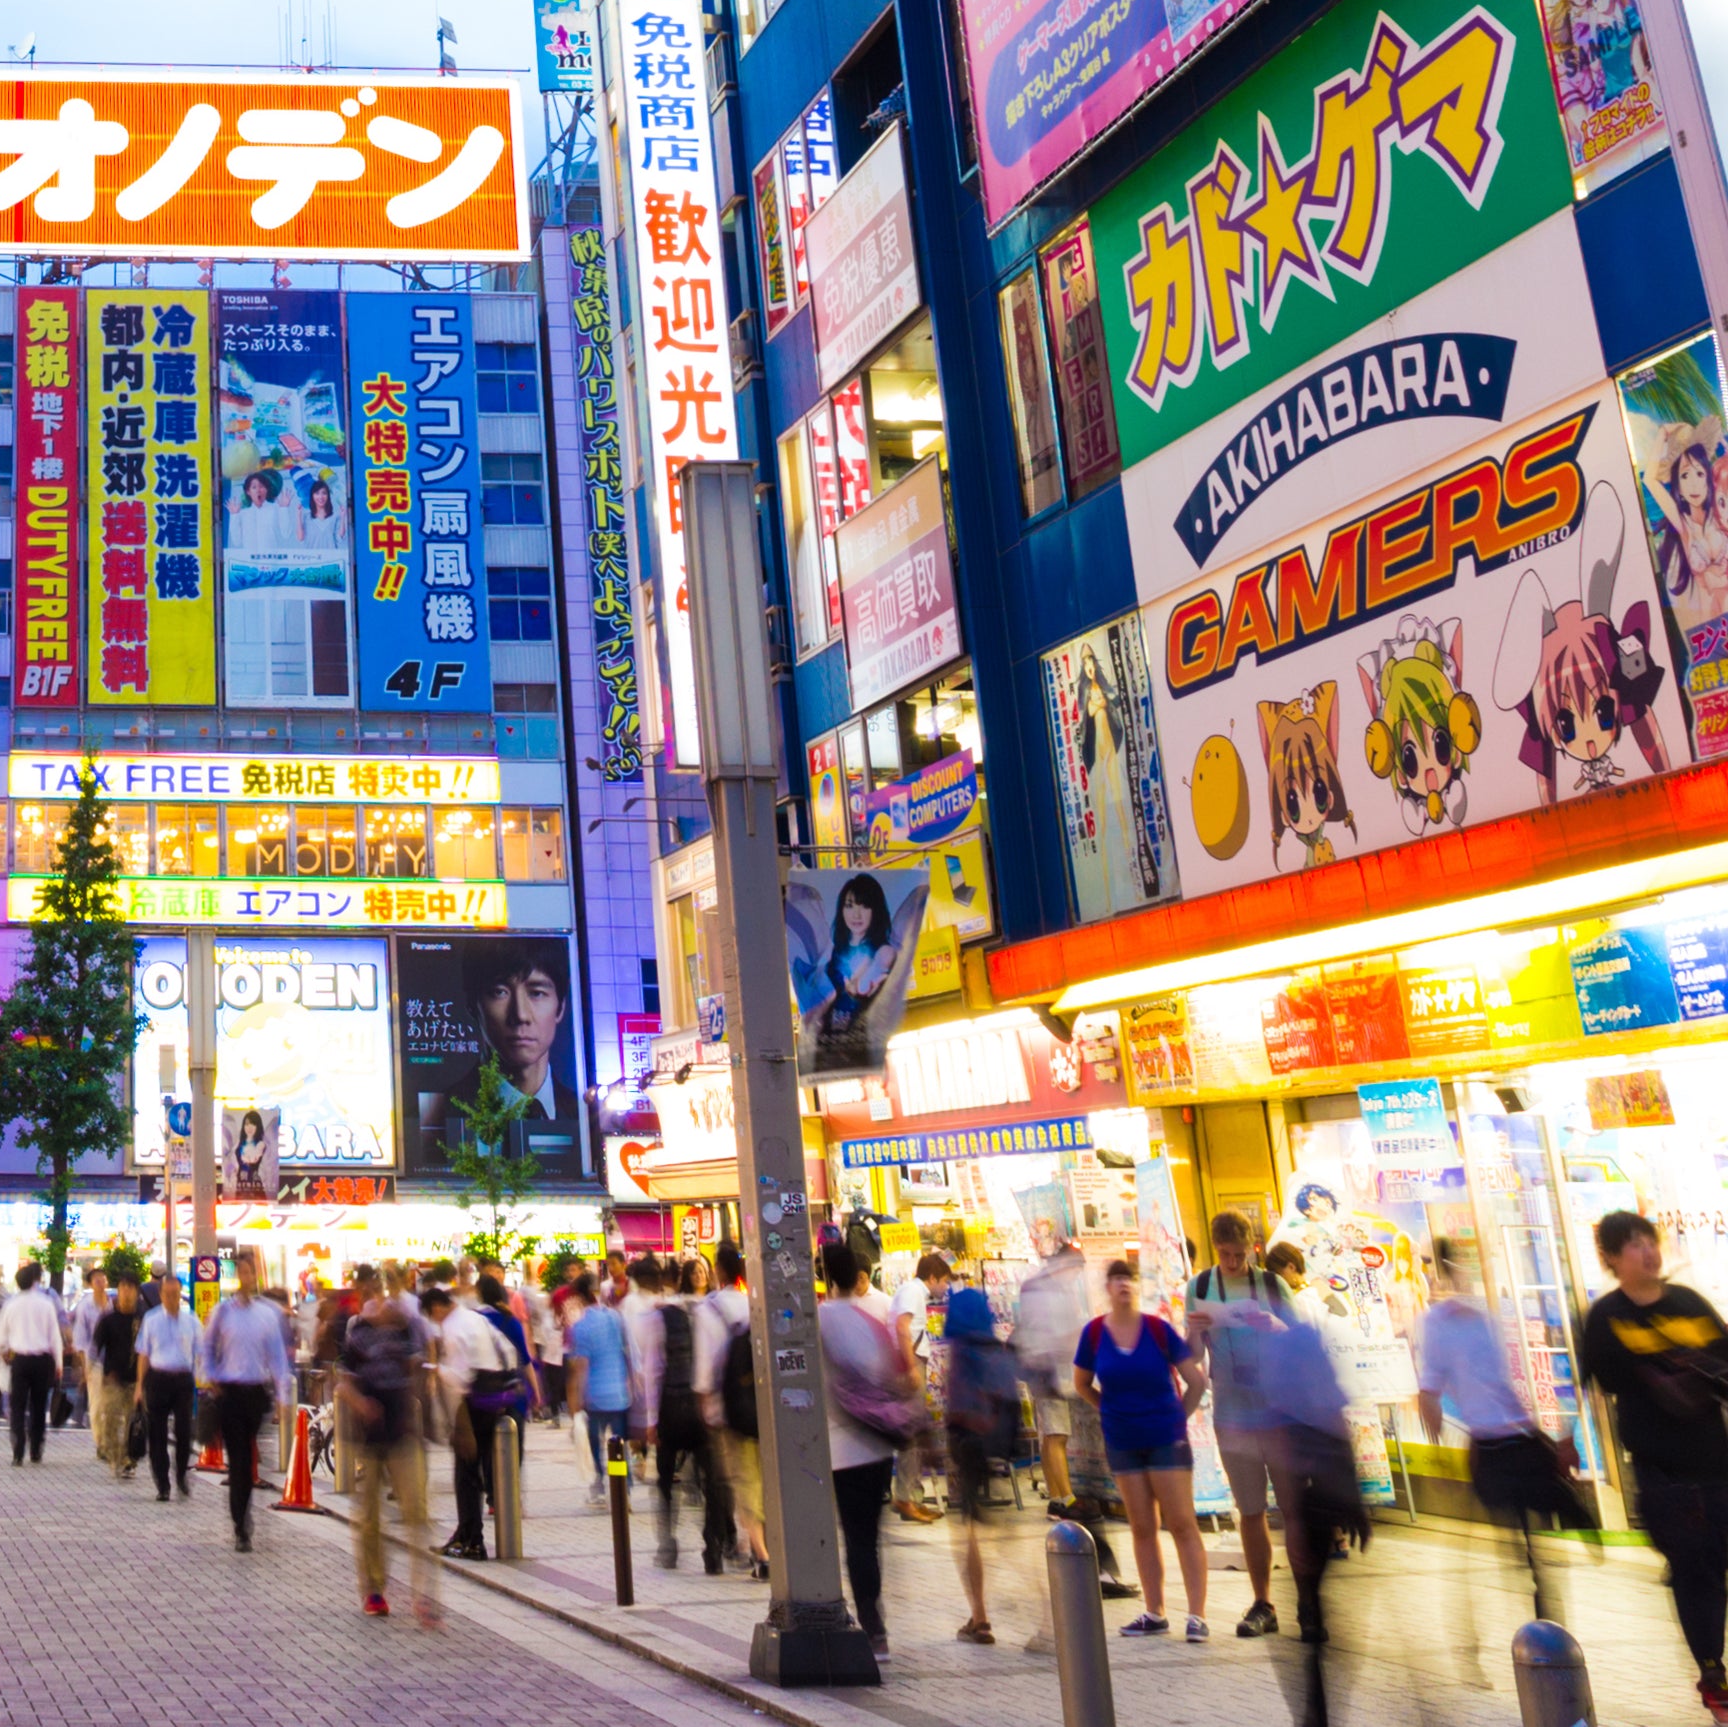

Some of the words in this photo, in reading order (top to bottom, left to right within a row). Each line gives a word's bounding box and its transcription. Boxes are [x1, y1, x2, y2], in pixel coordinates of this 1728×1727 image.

[630, 11, 704, 173] 免税商店
[222, 295, 269, 305] TOSHIBA
[25, 298, 72, 390] 免税
[222, 322, 339, 339] スペースそのまま、
[222, 338, 313, 353] たっぷり入る。
[843, 297, 896, 362] TAKARADA
[100, 303, 147, 498] 都内・近郊
[1207, 336, 1472, 537] AKIHABARA
[361, 372, 413, 603] 大特売中!!
[412, 305, 477, 645] エアコン扇風機
[1165, 406, 1594, 698] GAMERS
[1506, 526, 1572, 565] ANIBRO
[26, 485, 71, 664] DUTYFREE
[101, 500, 150, 694] 送料無料
[852, 552, 942, 650] 高価買取
[877, 633, 935, 685] TAKARADA
[20, 665, 73, 698] B1F
[383, 658, 467, 702] 4F
[30, 763, 113, 793] TAX
[126, 764, 231, 794] FREE
[239, 762, 336, 797] 免税店
[347, 763, 476, 798] 特売中!!
[813, 748, 834, 774] 2F
[909, 761, 964, 805] DISCOUNT
[908, 788, 974, 831] COMPUTERS
[870, 821, 891, 852] 2F
[128, 887, 221, 916] 冷蔵庫
[236, 890, 353, 917] エアコン
[363, 887, 488, 921] 特売中!!
[410, 941, 453, 952] Panasonic
[140, 960, 379, 1012] OODEN
[405, 998, 455, 1019] 教えて
[406, 1019, 475, 1040] あげたい
[629, 1036, 646, 1048] 4F
[631, 1051, 649, 1063] 3F
[635, 1099, 652, 1111] B1
[312, 1176, 389, 1204] 大特売!
[780, 1204, 805, 1214] ONE
